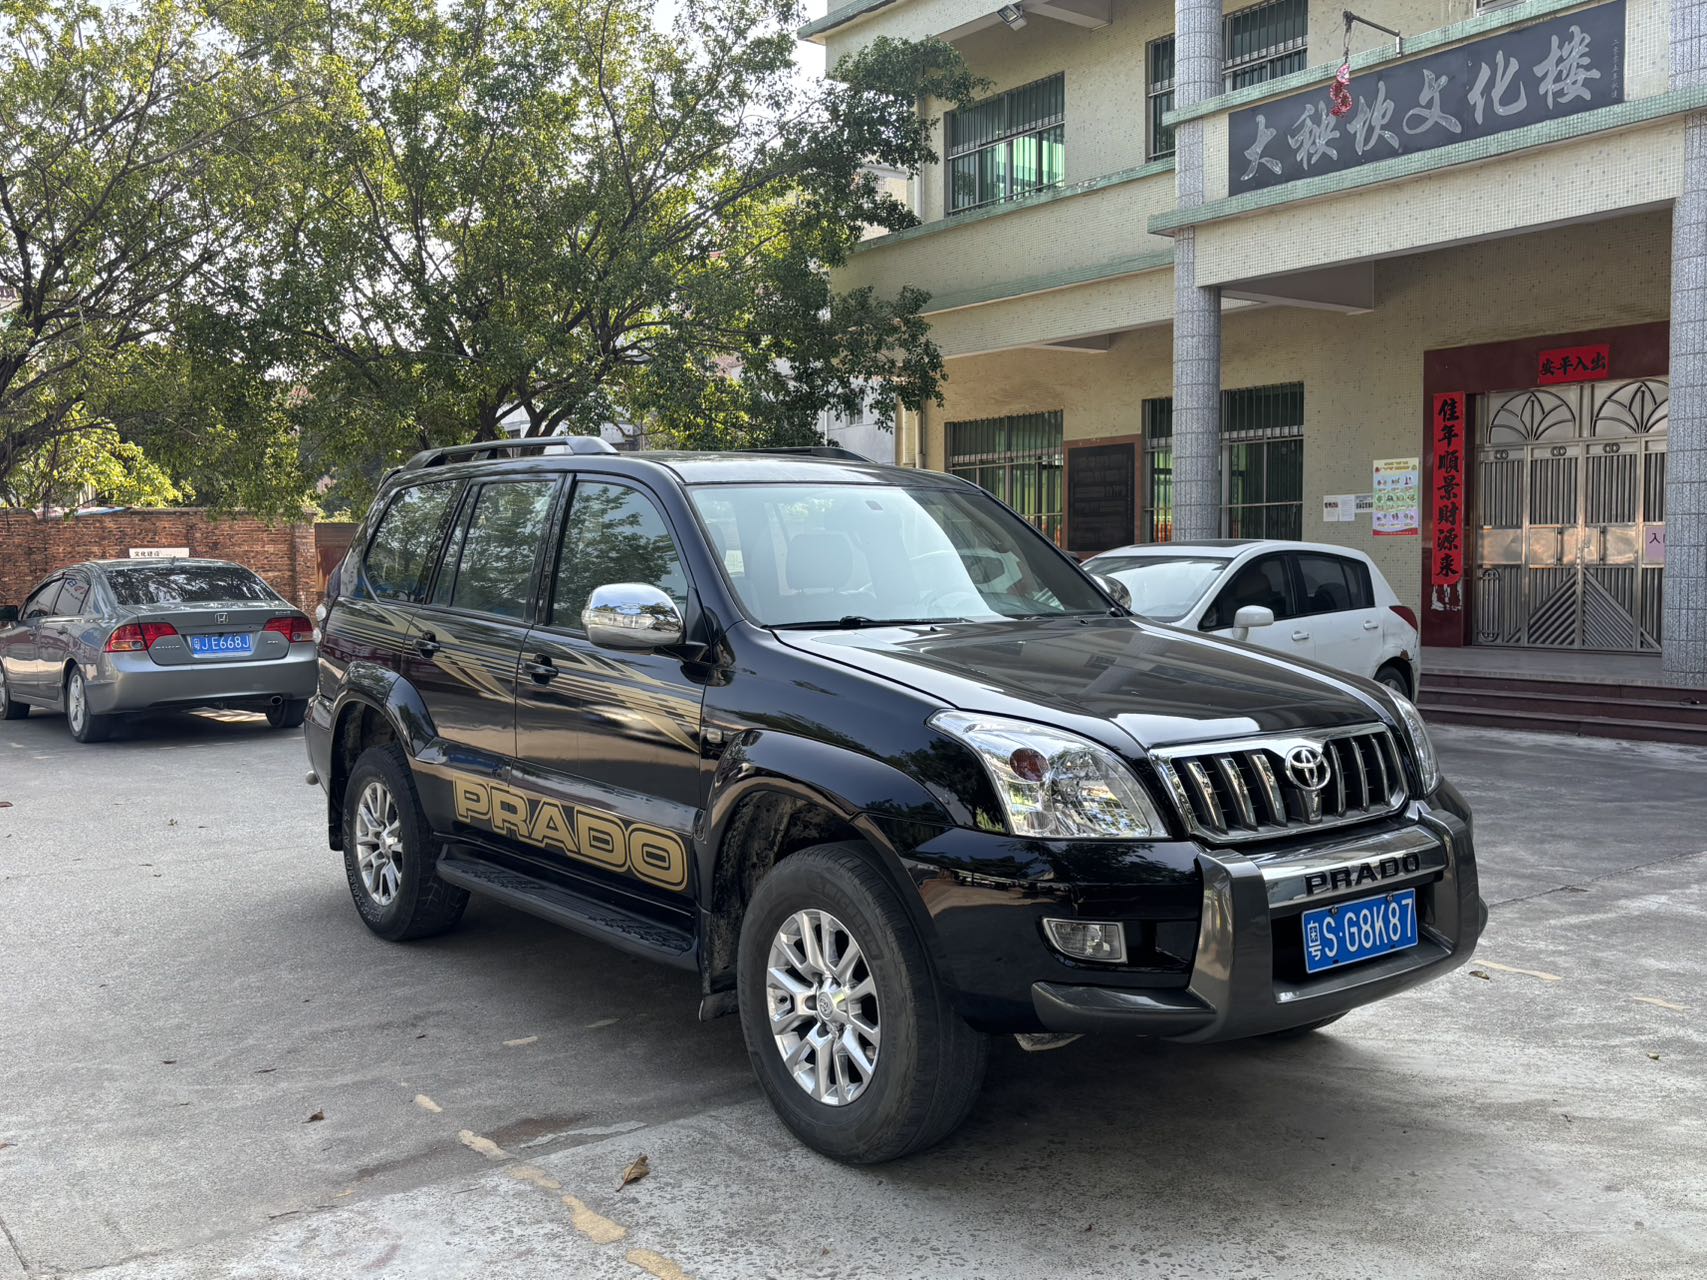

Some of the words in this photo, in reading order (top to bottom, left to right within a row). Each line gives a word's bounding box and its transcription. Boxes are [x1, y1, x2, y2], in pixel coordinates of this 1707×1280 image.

[1649, 532, 1666, 544] 入
[452, 774, 688, 891] PRADO
[1304, 852, 1420, 897] PRADO
